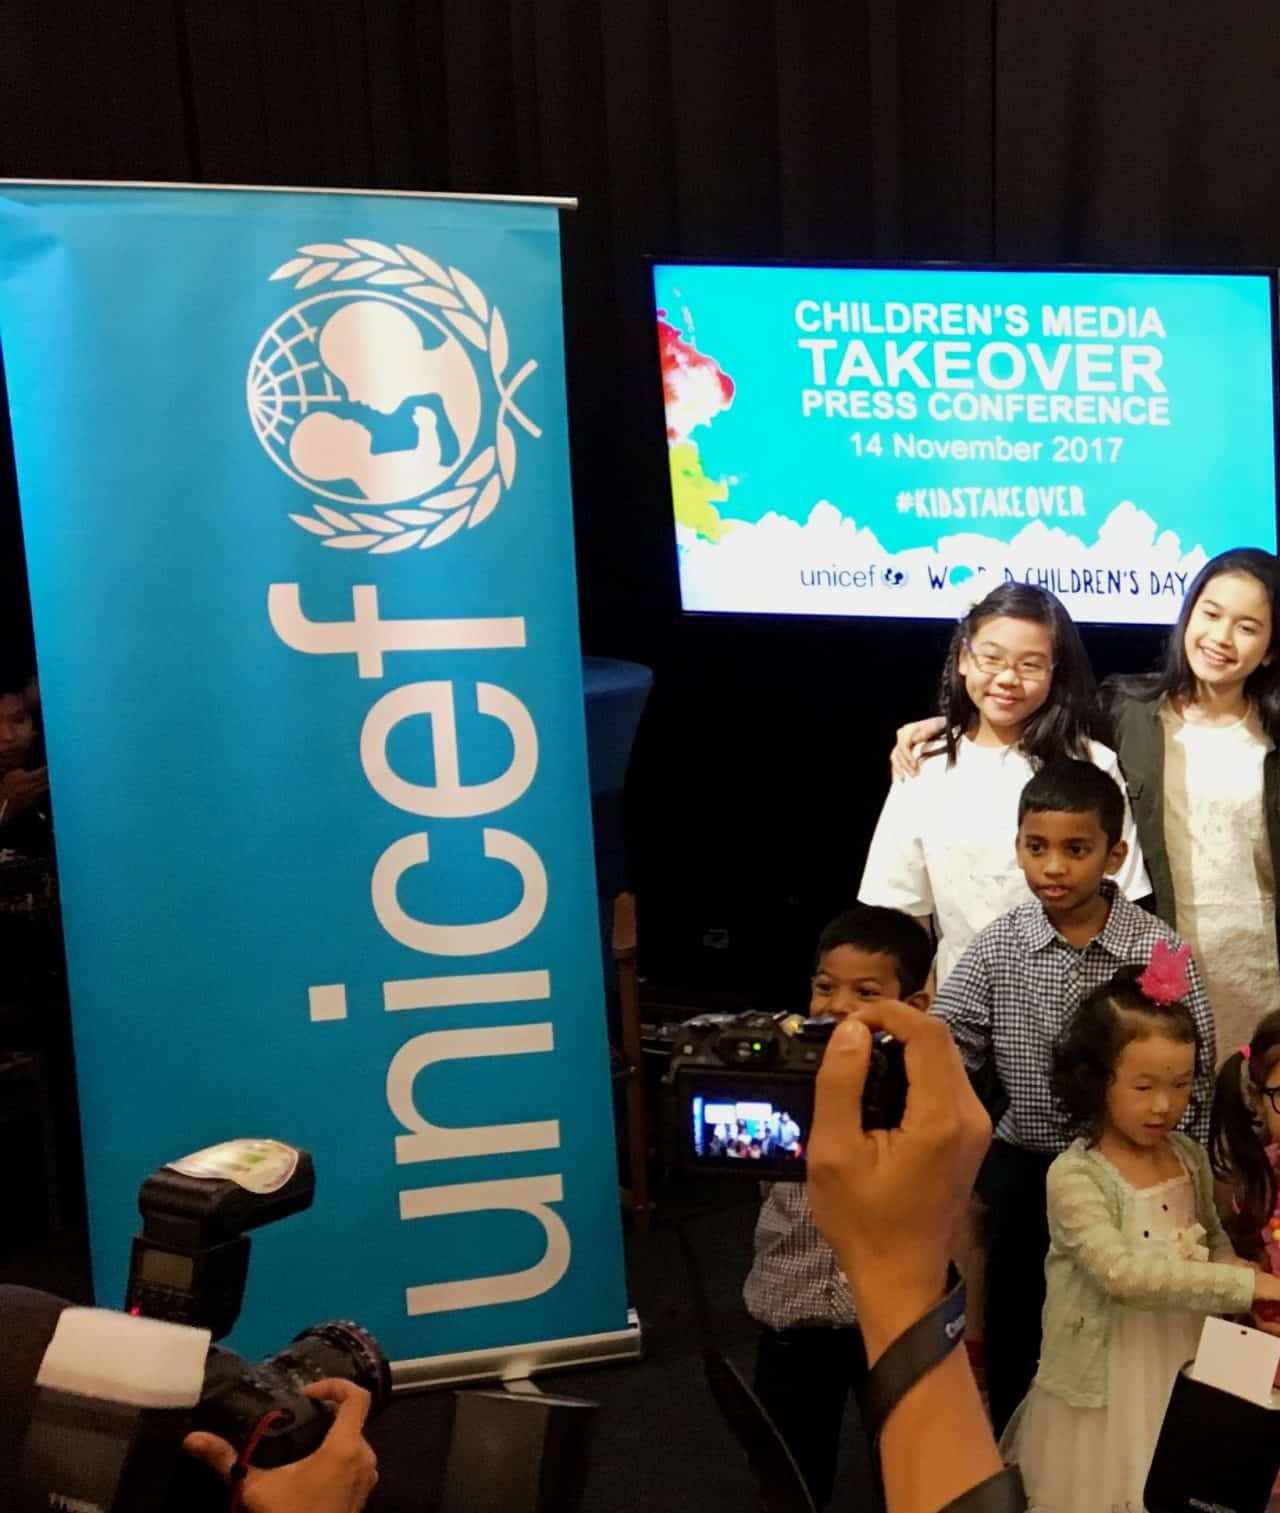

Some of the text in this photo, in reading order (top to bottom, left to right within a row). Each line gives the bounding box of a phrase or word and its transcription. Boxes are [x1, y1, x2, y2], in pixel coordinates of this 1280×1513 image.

[794, 300, 1167, 339] CHILDREN'S MEDIA
[797, 338, 1168, 393] TAKEOVER
[802, 390, 1172, 426] PRESS CONFERENCE
[849, 432, 1124, 462] 14 November 2017
[896, 486, 1086, 519] #KIDSTAKEOVER
[800, 564, 876, 588] unicef
[1150, 571, 1189, 596] DAY
[267, 582, 571, 1317] unicef
